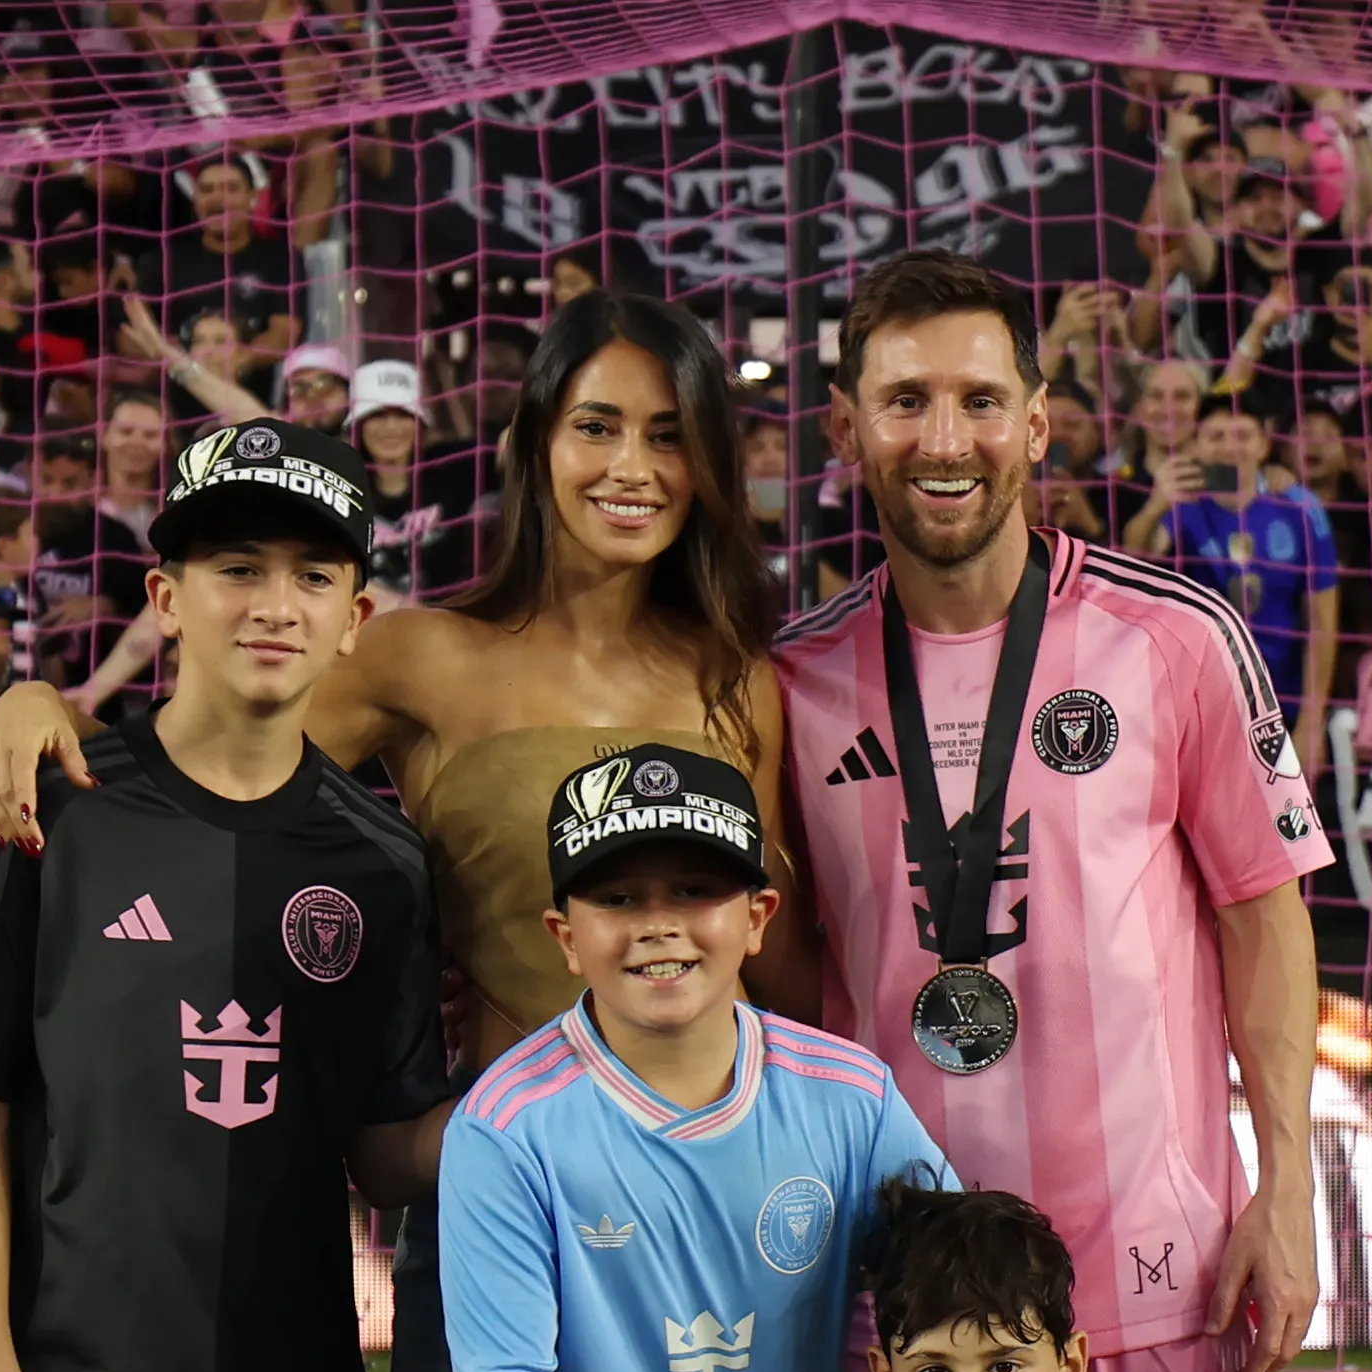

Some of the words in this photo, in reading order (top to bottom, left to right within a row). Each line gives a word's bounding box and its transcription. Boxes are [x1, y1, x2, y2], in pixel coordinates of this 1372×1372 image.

[282, 458, 321, 478] MLS
[323, 469, 353, 495] CUP
[1033, 691, 1102, 730] INTERNACIONAL
[1057, 710, 1092, 720] MIAMI
[1101, 703, 1113, 717] DE
[933, 722, 956, 733] INTER
[958, 720, 980, 731] MIAMI
[1253, 720, 1285, 743] MLS
[947, 749, 963, 759] MLS
[965, 747, 980, 758] CUP
[1034, 733, 1047, 757] CLUB
[933, 759, 969, 770] ECEMBER
[1061, 764, 1091, 773] MMXX
[562, 818, 579, 834] 20
[611, 798, 633, 811] 25
[684, 795, 719, 813] MLS
[721, 803, 749, 826] CUP
[565, 808, 750, 858] CHAMPIONS
[288, 891, 350, 924] INTERNACIONAL
[310, 911, 342, 922] MIAMI
[287, 928, 300, 954] CLUB
[784, 1203, 815, 1214] MIAMI
